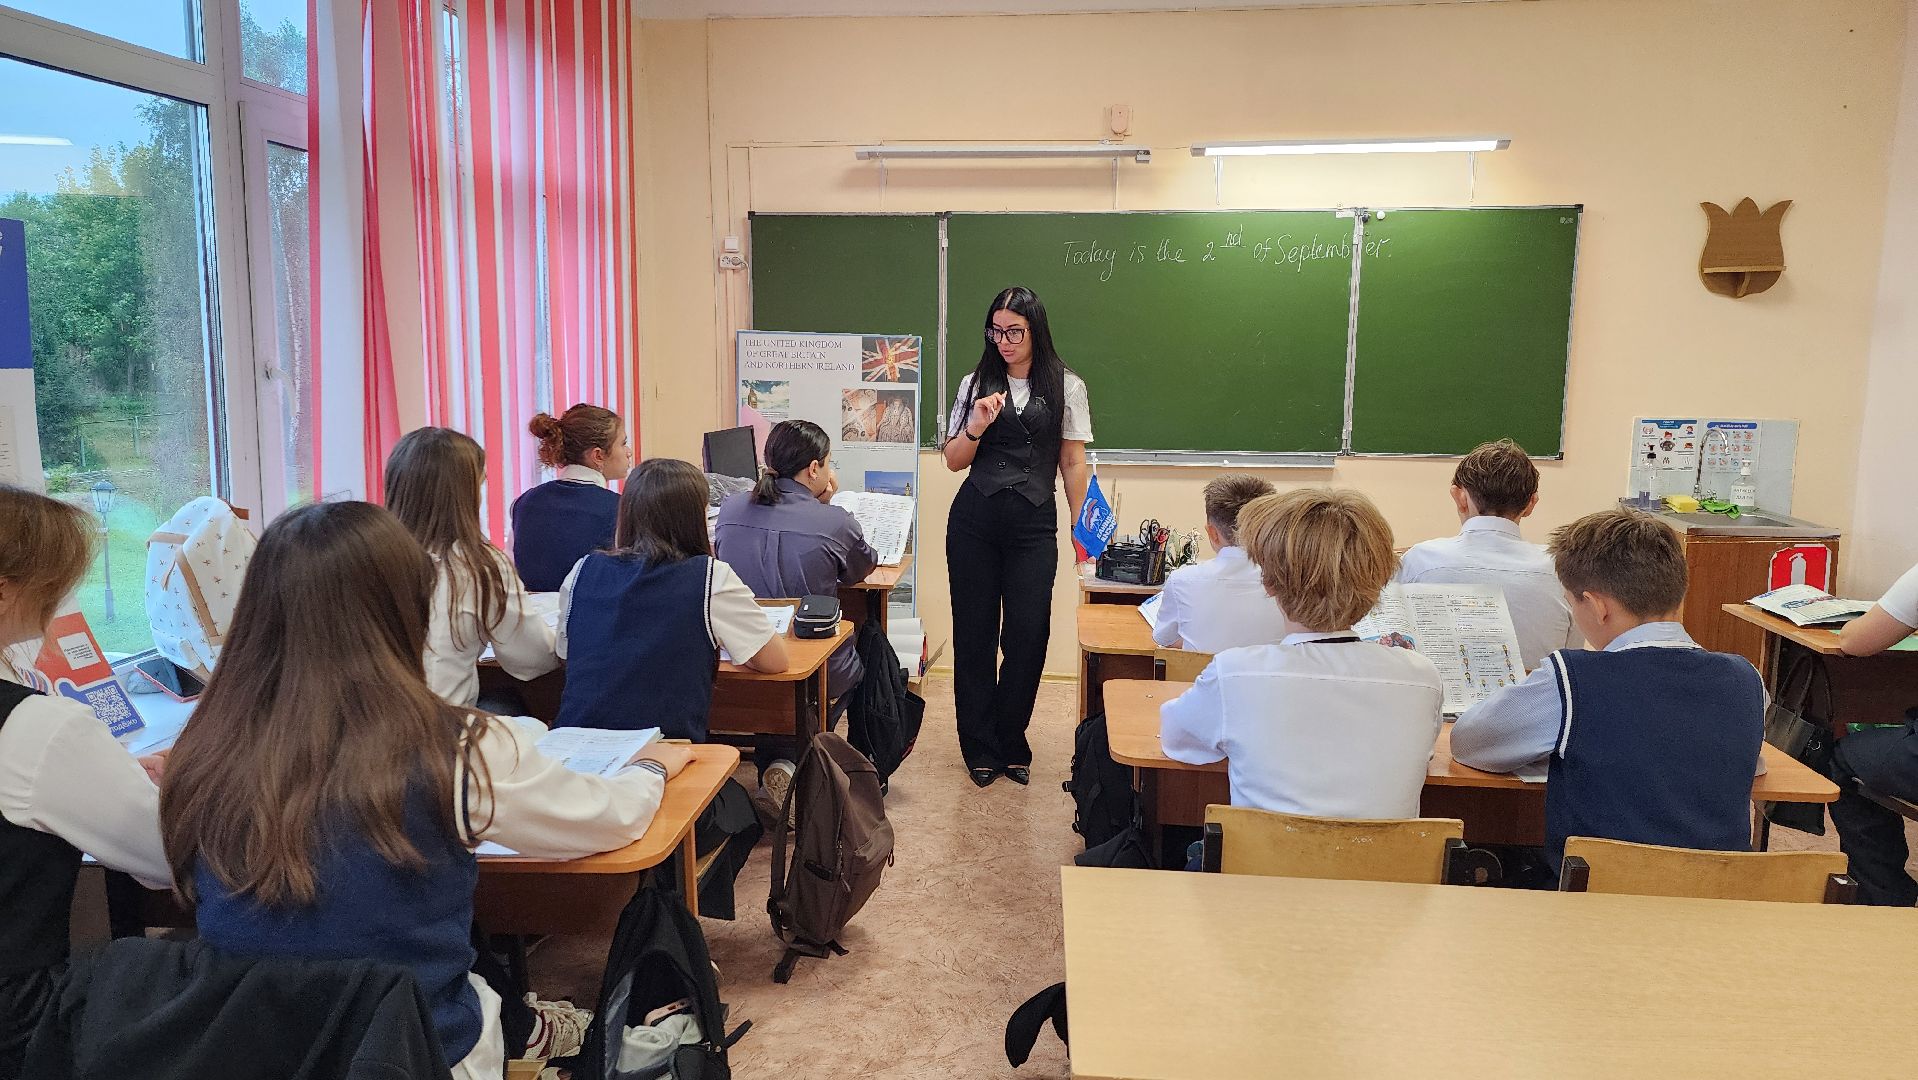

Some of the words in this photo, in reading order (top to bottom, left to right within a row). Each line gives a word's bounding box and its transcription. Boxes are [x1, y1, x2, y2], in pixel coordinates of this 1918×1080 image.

[1063, 240, 1118, 282] Today
[1129, 241, 1146, 263] is
[1156, 238, 1187, 263] the
[1253, 237, 1272, 262] of
[744, 339, 761, 347] THE
[763, 339, 797, 348] UNITED
[799, 340, 842, 349] KINGDOM
[746, 350, 757, 358] OF
[760, 350, 787, 358] GREAT
[791, 351, 826, 359] BRITAIN
[744, 361, 763, 369] AND
[765, 361, 813, 370] NORTHERN
[816, 362, 855, 372] IRELAND
